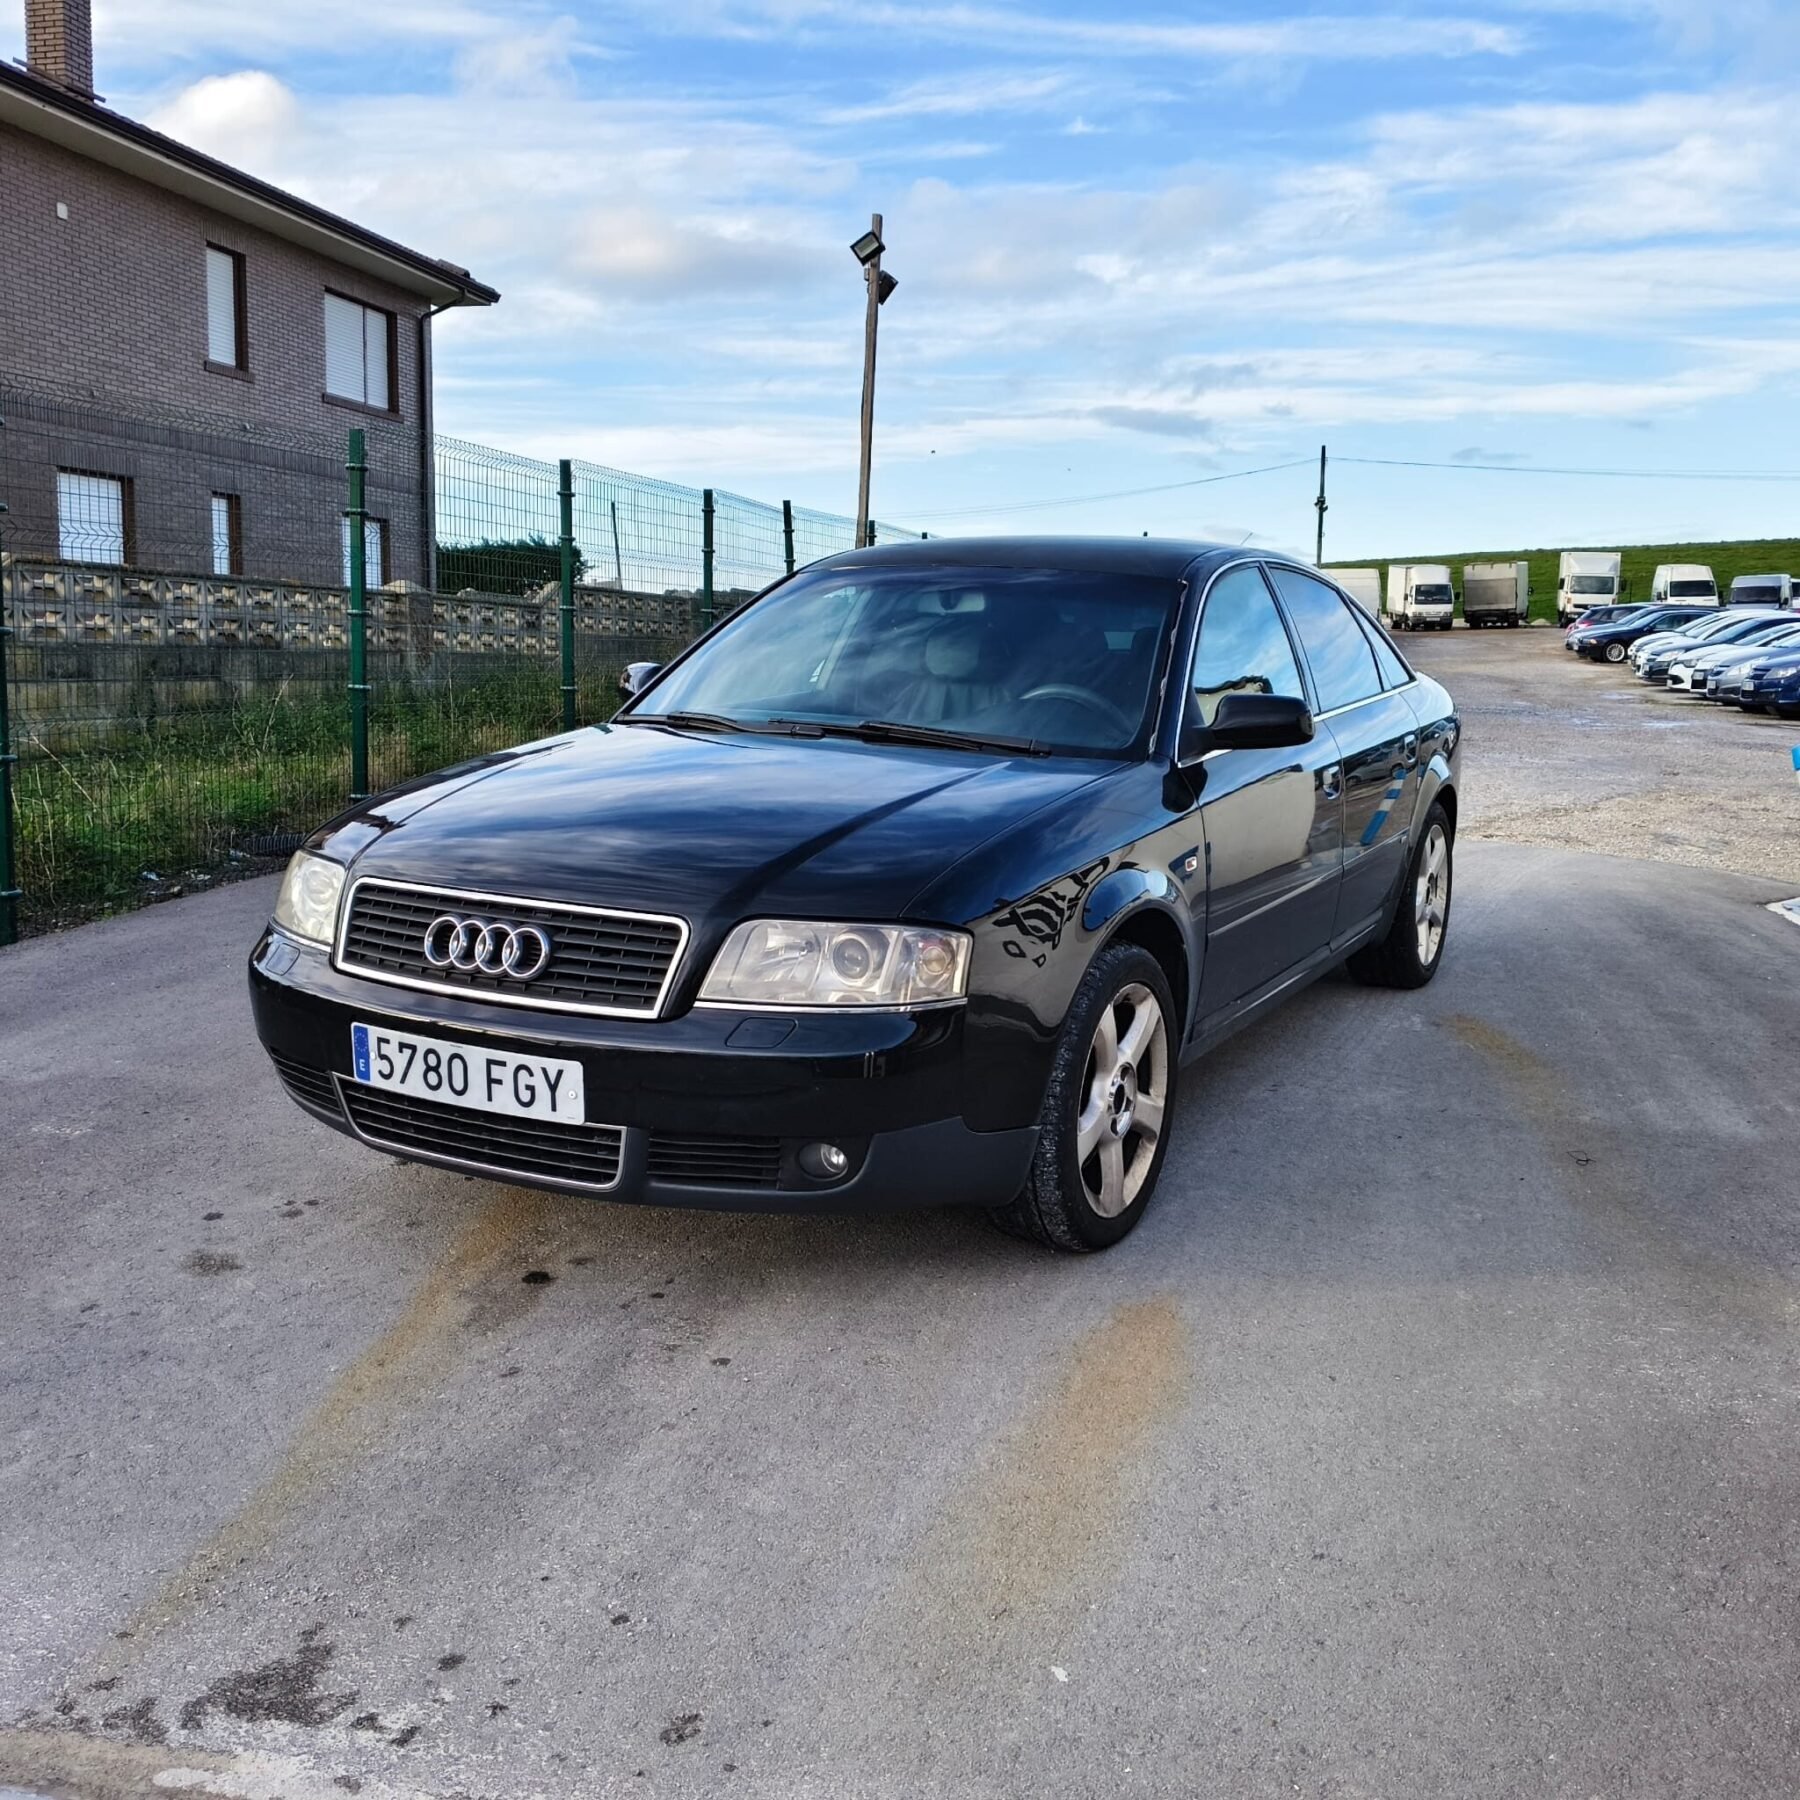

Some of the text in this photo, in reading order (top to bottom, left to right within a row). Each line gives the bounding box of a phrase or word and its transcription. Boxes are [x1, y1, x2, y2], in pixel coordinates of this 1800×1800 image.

[359, 1059, 366, 1071] E
[376, 1037, 564, 1112] 5780 FGY
